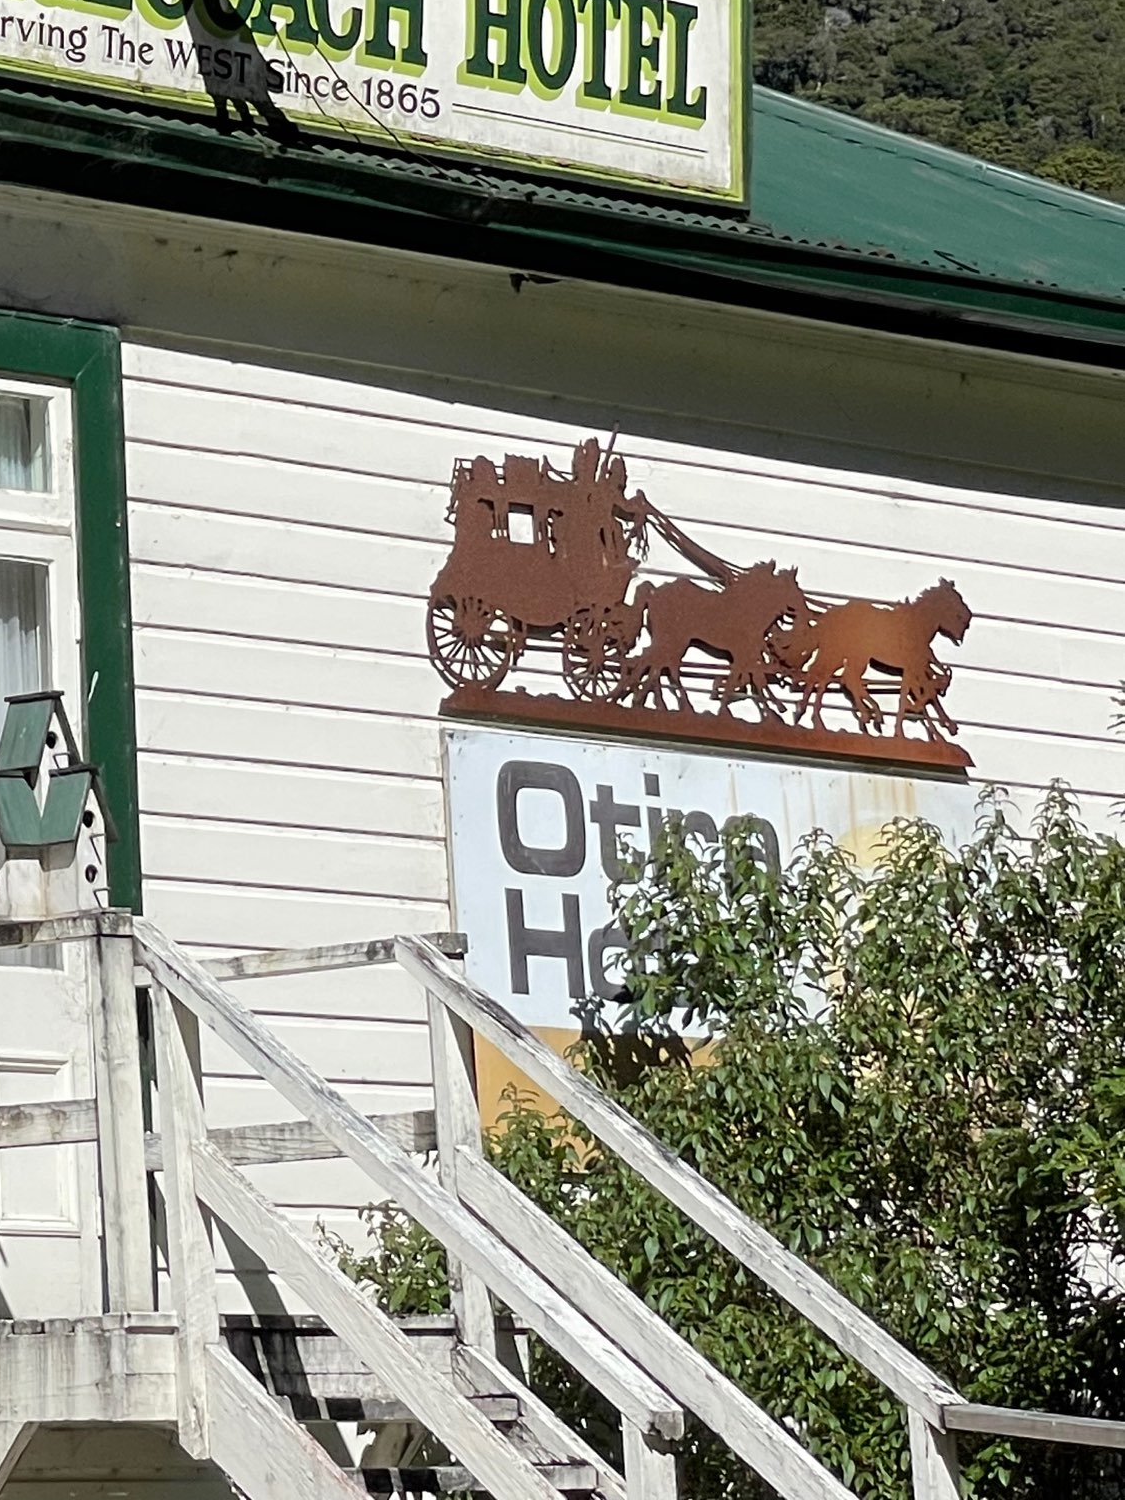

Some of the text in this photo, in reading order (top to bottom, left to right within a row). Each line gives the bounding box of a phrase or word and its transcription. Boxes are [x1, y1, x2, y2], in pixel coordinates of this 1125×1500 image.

[101, 25, 155, 66] The
[164, 38, 252, 84] WEST
[265, 58, 350, 102] Since
[361, 77, 442, 119] 1865
